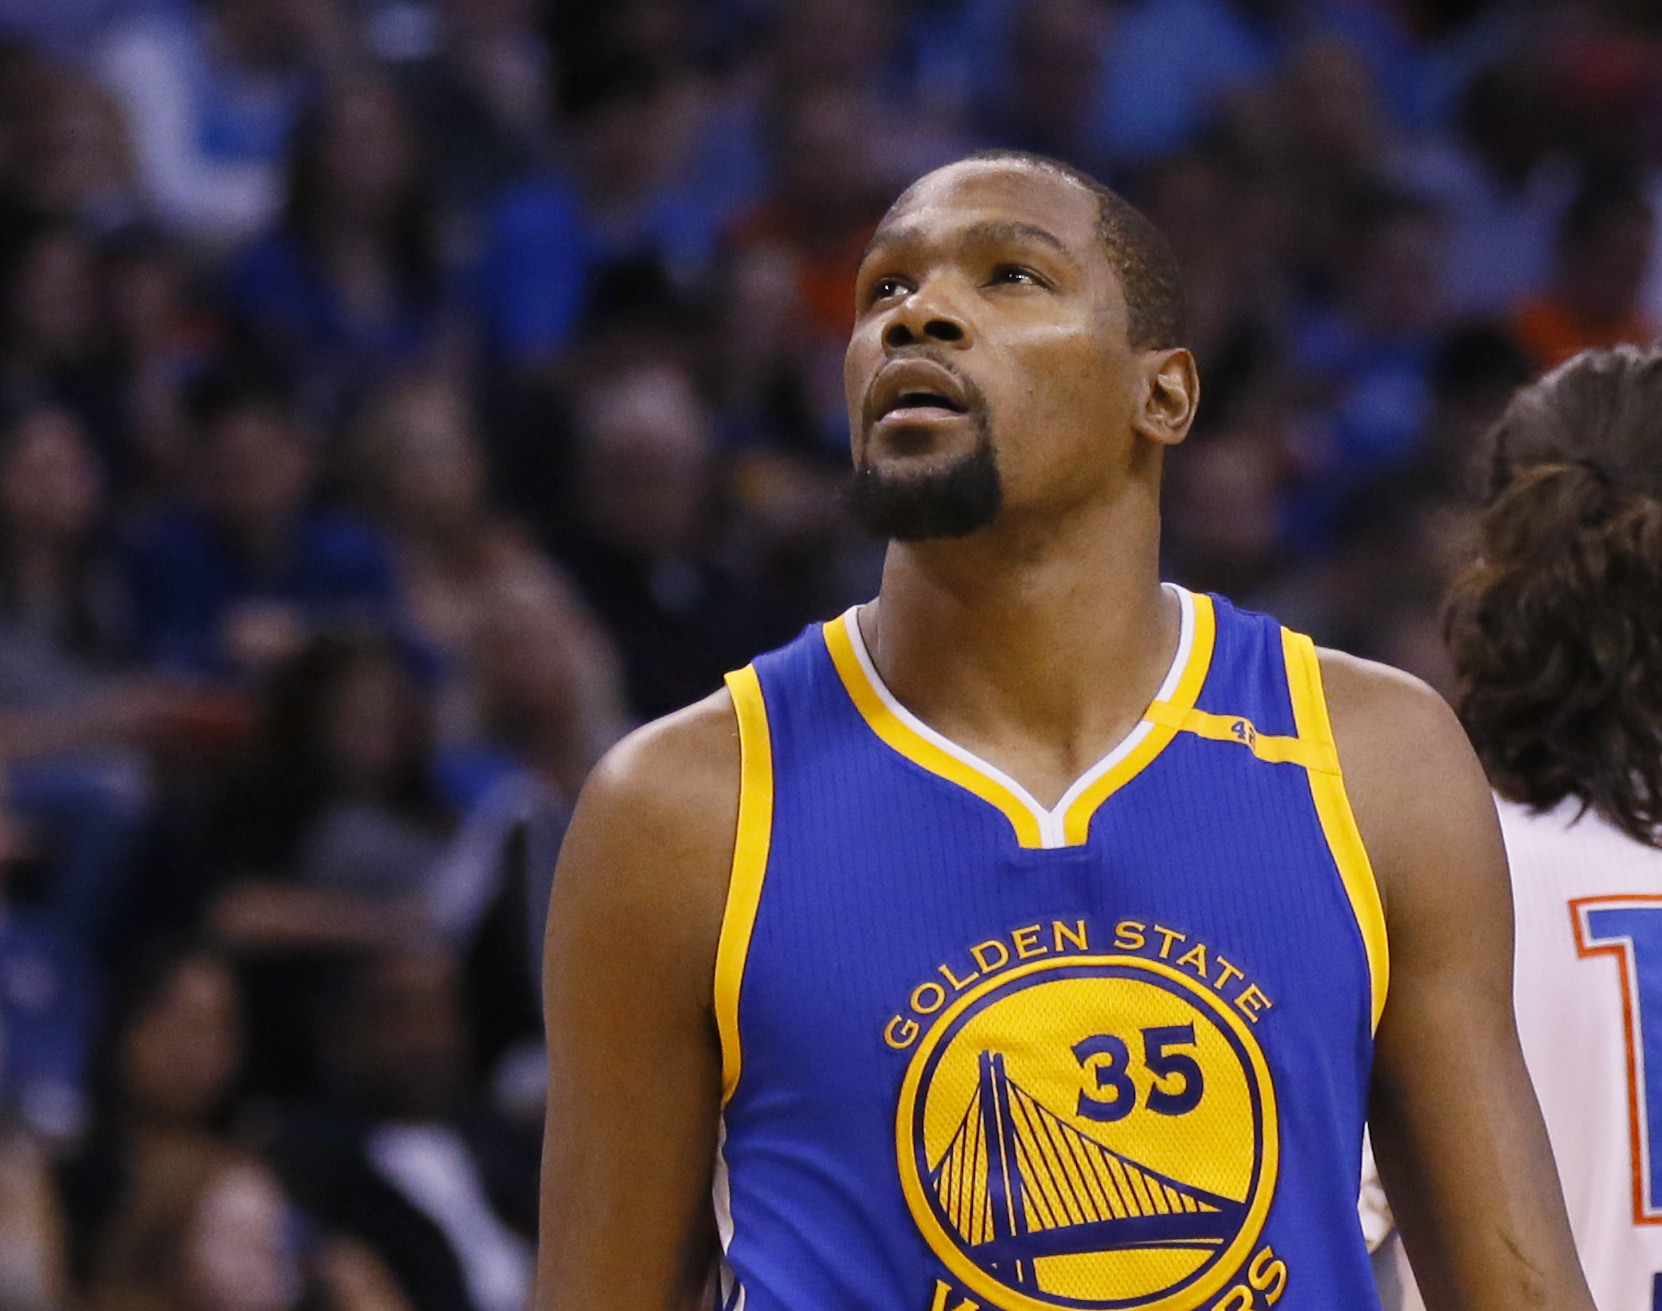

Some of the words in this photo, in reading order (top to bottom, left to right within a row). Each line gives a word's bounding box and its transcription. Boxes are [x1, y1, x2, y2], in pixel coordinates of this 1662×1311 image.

[884, 919, 1090, 1050] GOLDEN
[1113, 920, 1274, 1024] STATE
[1070, 1020, 1205, 1122] 35
